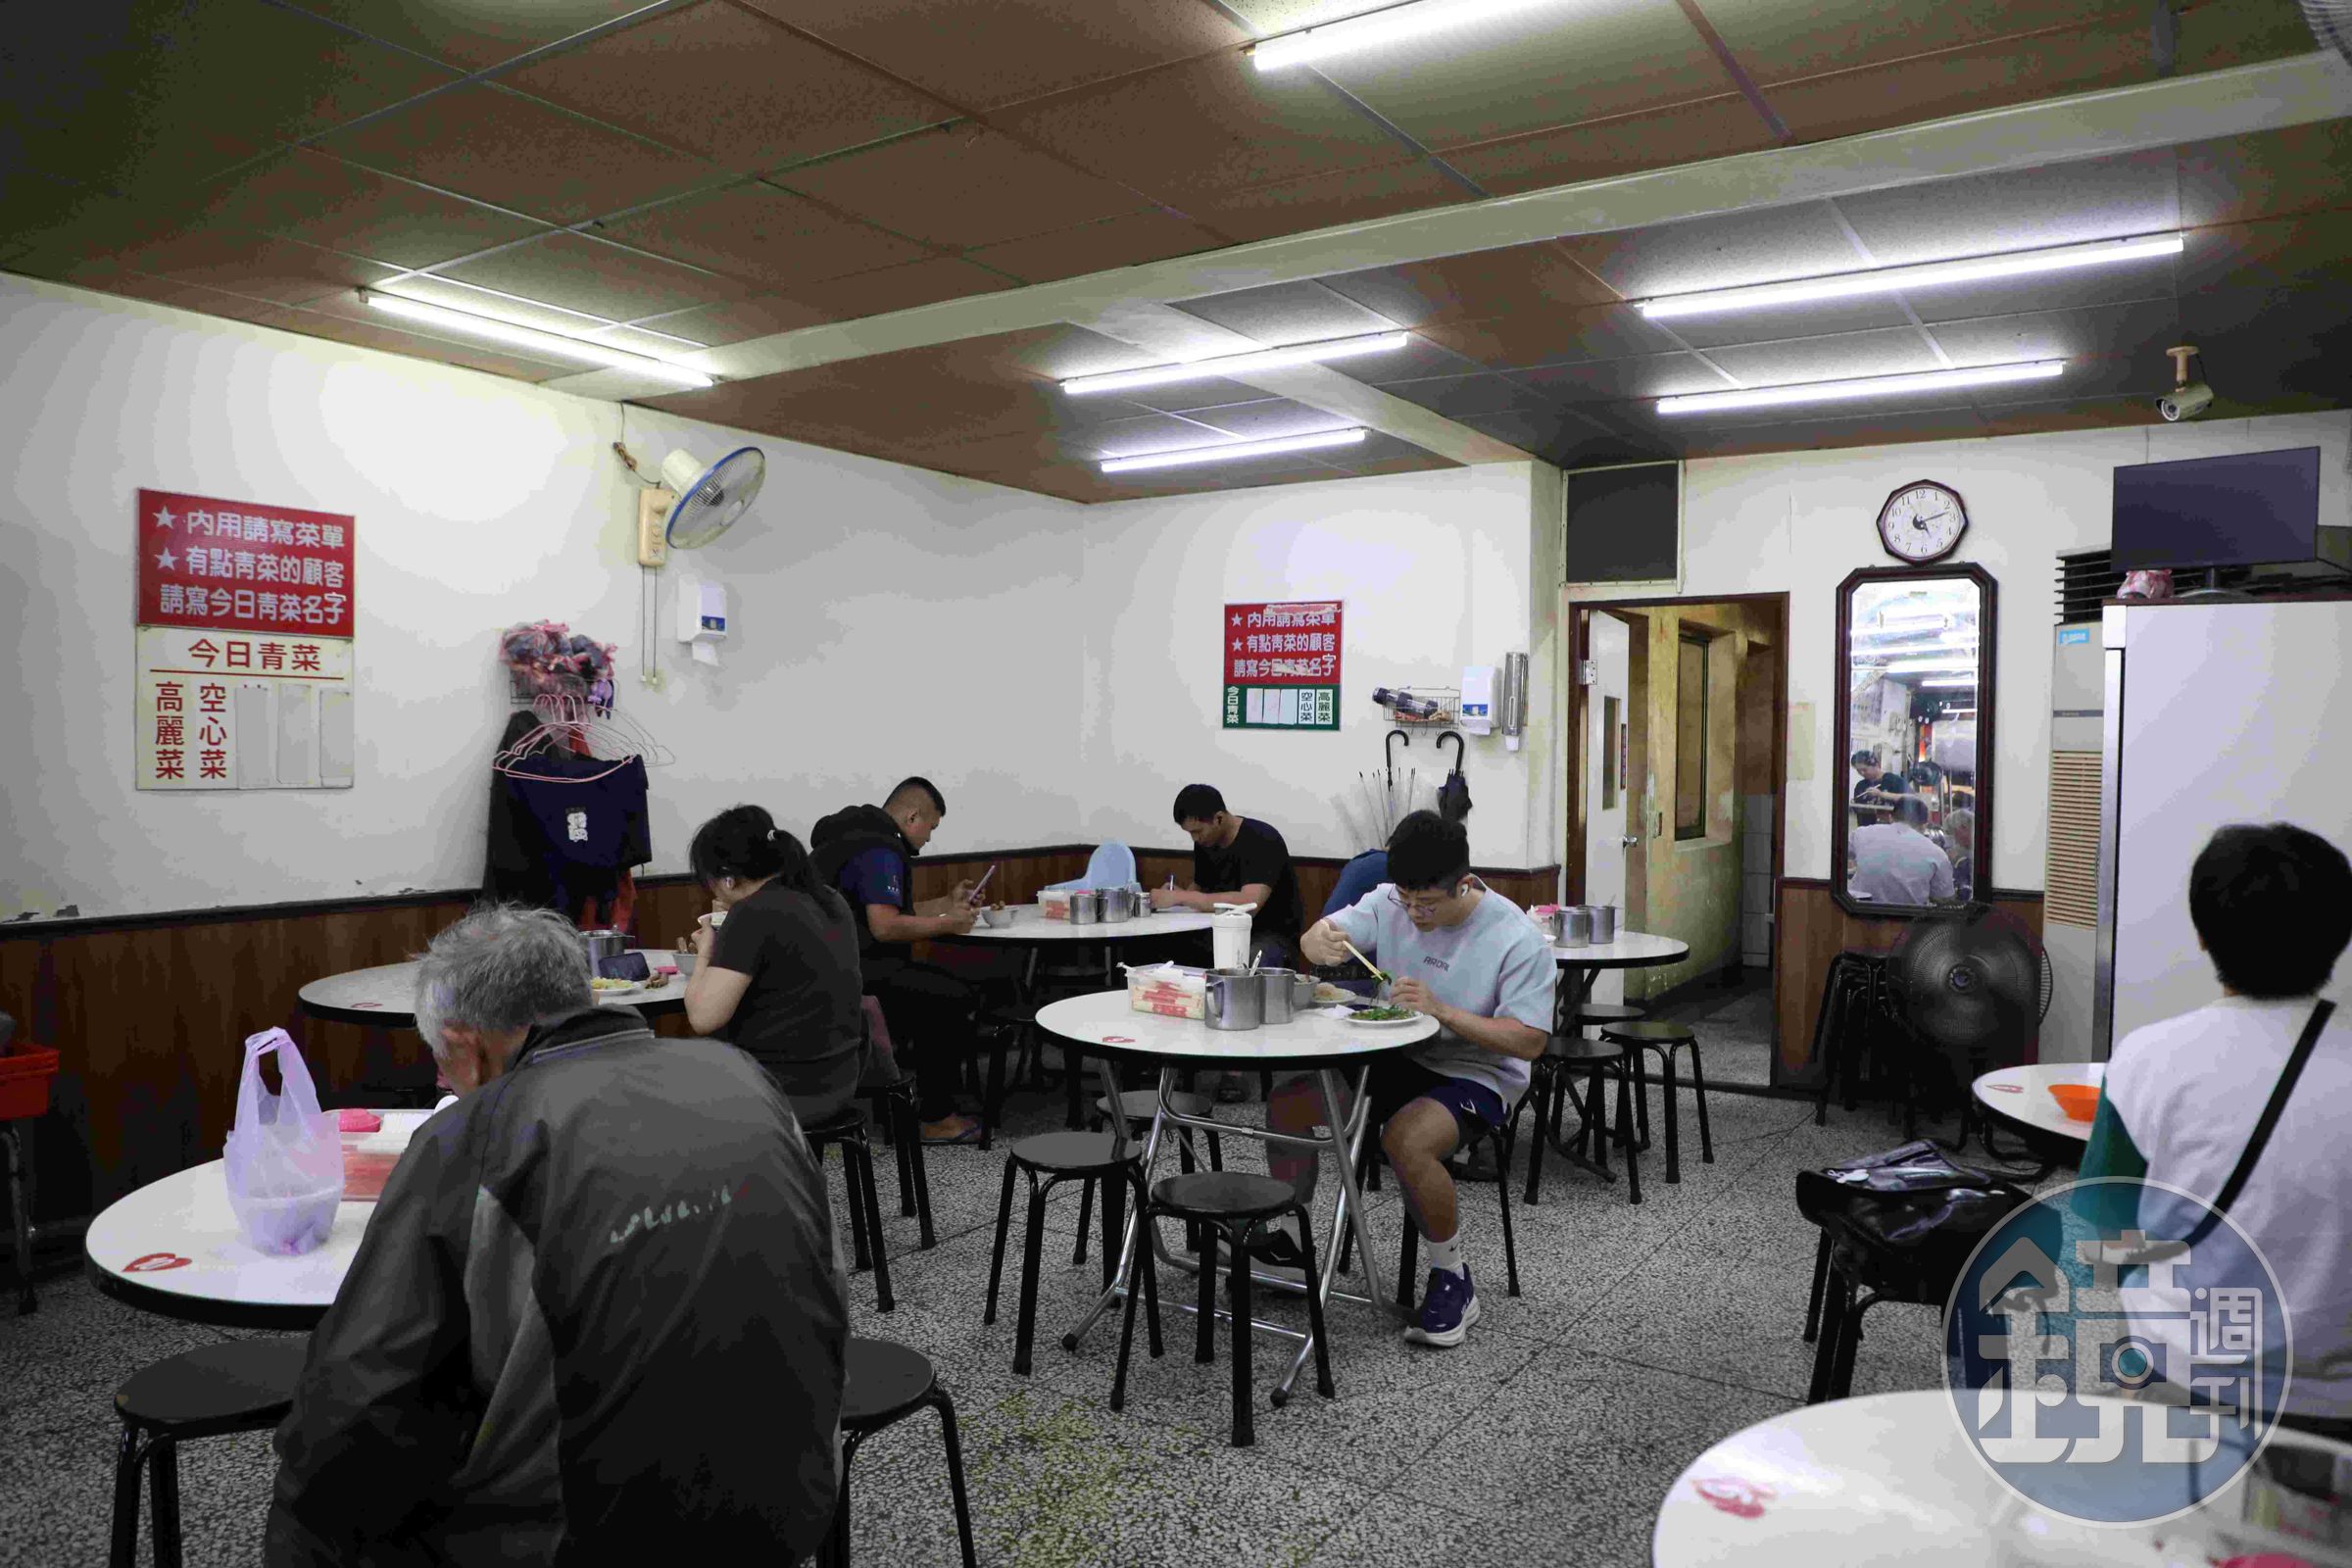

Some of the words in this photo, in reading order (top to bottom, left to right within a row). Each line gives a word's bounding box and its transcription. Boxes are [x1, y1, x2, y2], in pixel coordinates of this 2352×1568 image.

[1915, 489, 1927, 500] 12
[1901, 496, 1911, 506] 11
[1944, 501, 1951, 510] 2
[1891, 508, 1902, 517] 10
[1949, 513, 1956, 522] 3
[1887, 520, 1895, 530] 9
[1893, 534, 1901, 543] 8
[1936, 538, 1943, 549] 5
[1905, 542, 1912, 553] 7
[1920, 544, 1928, 555] 6
[185, 546, 345, 589] 有點青菜的顧客
[160, 583, 346, 626] 請寫今日青菜名字
[1247, 632, 1336, 654] 有點青菜的顧客
[188, 638, 321, 672] 今日青菜
[1300, 691, 1313, 722] 空心菜
[1317, 691, 1331, 722] 高麗菜
[155, 680, 184, 780] 高麗菜
[199, 682, 227, 780] 空心菜
